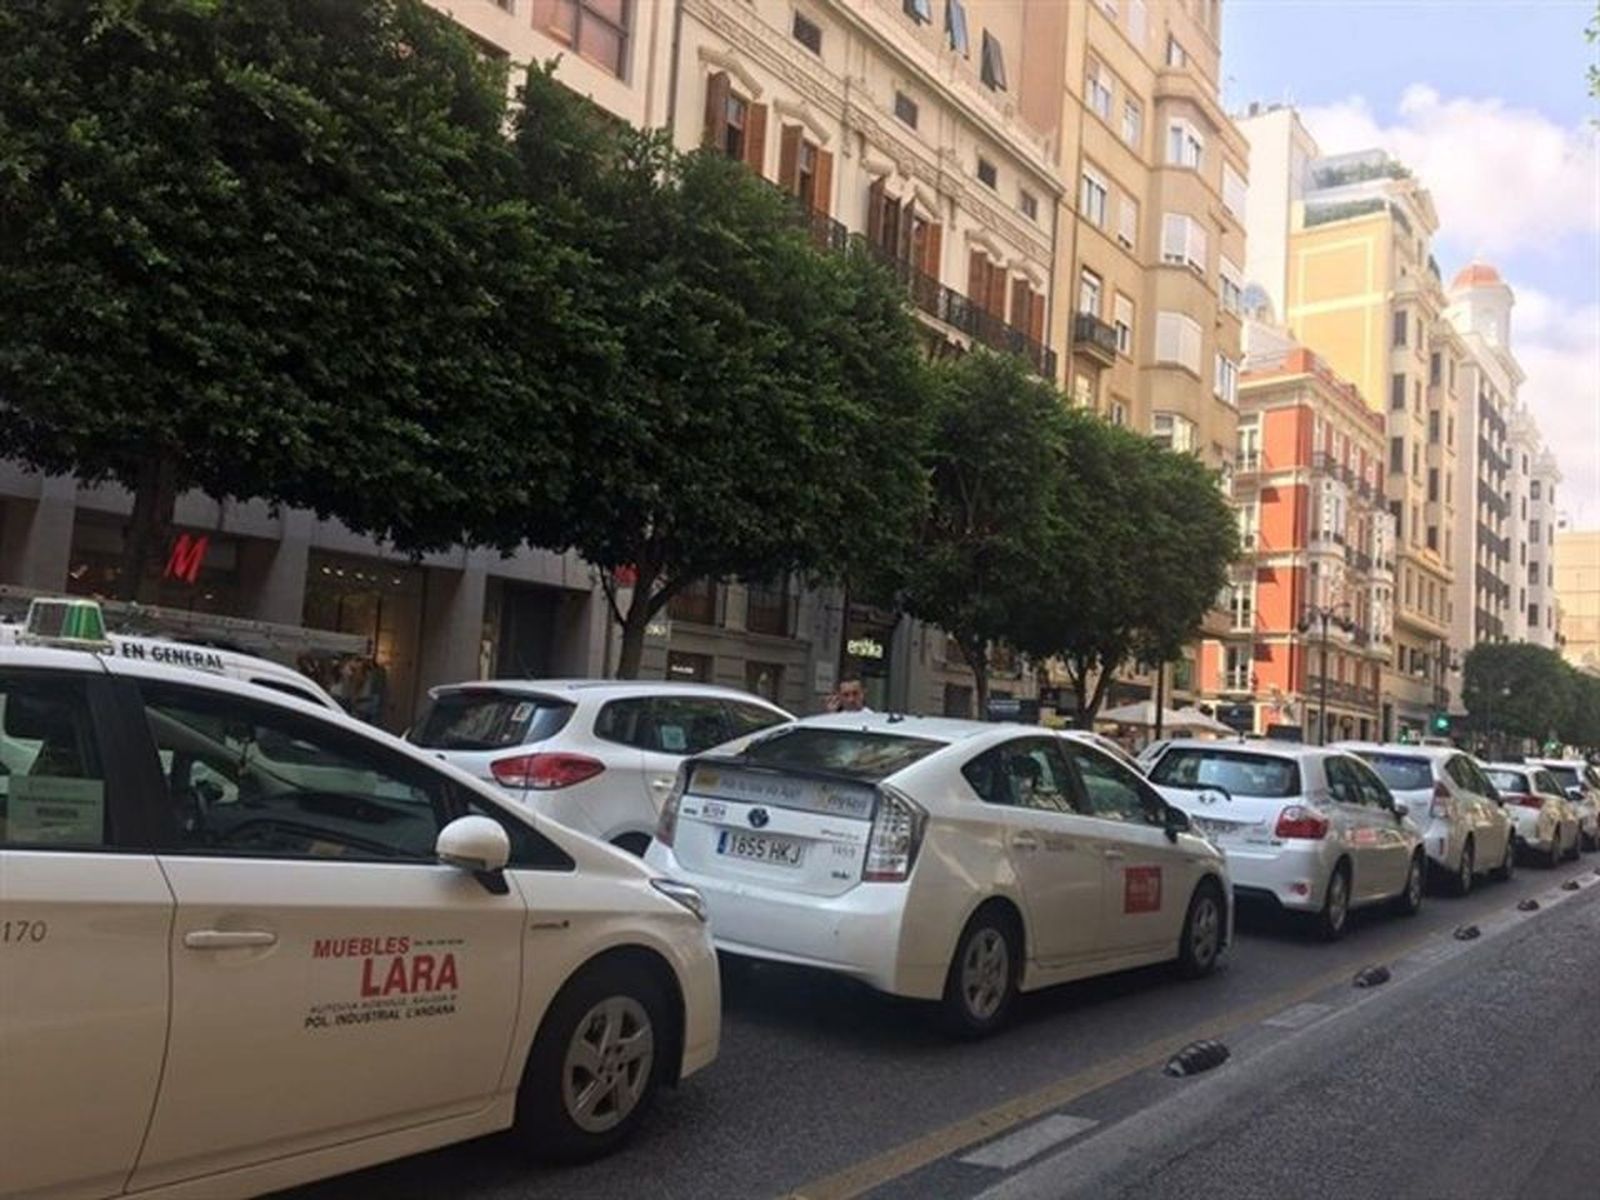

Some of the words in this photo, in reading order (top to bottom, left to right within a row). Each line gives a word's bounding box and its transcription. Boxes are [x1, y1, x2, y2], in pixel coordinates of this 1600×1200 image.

[122, 643, 145, 660] EN
[151, 646, 224, 669] GENERAL
[769, 841, 800, 864] HKJ
[4, 919, 47, 943] 170
[313, 937, 410, 958] MUEBLES
[361, 953, 459, 997] LARA
